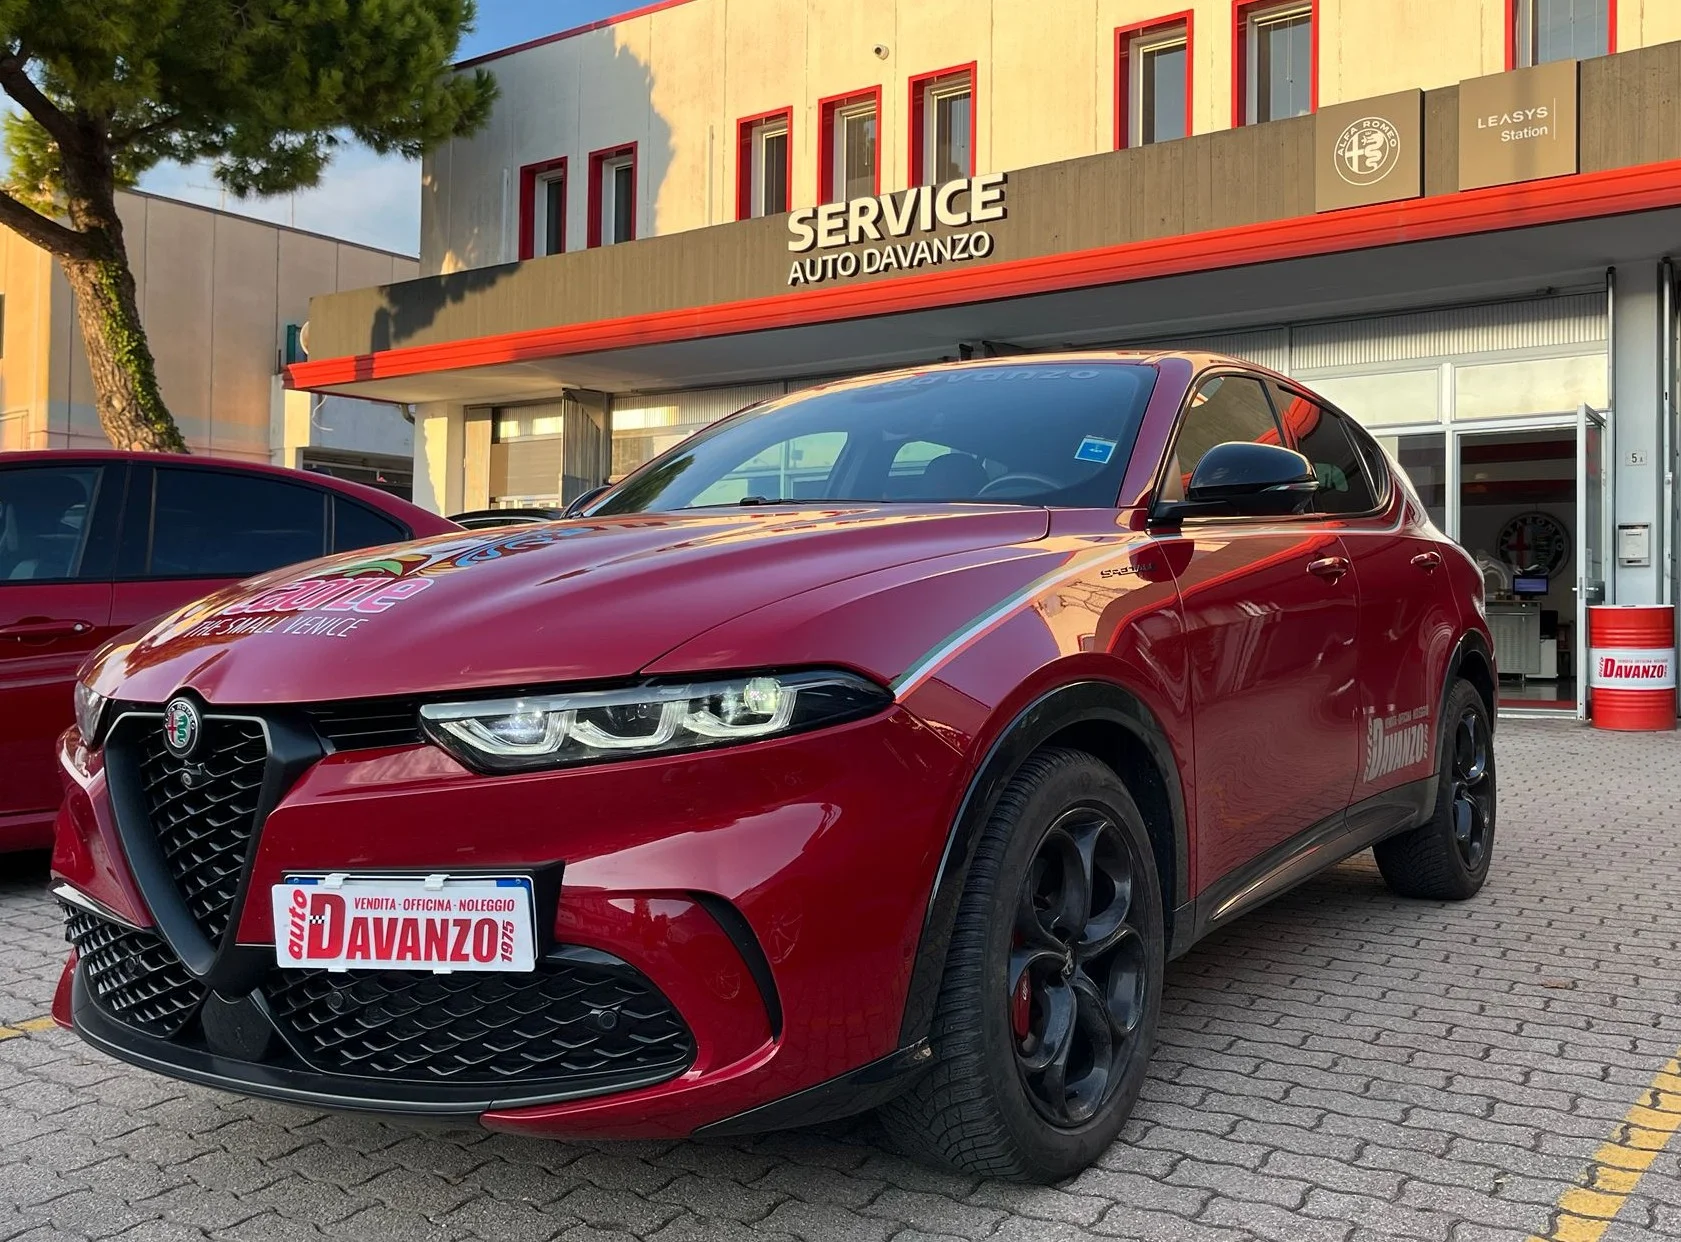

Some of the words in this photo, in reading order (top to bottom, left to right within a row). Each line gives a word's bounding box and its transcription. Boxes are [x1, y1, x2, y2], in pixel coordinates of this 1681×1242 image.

[1477, 106, 1548, 129] LEASYS
[1338, 127, 1358, 156] ALFA
[1363, 121, 1397, 147] ROMEO
[1500, 125, 1548, 142] Station
[788, 172, 1004, 252] SERVICE
[788, 252, 858, 285] AUTO
[863, 231, 991, 273] DAVANZO
[1631, 453, 1638, 463] 5
[183, 620, 222, 638] THE
[216, 616, 289, 635] SMALL
[282, 616, 369, 638] VENICE
[1603, 658, 1664, 678] DAVANZO
[354, 897, 396, 911] VENDITA
[403, 898, 451, 912] OFFICINA
[459, 899, 515, 912] NOLEGGIO
[288, 889, 307, 960] auto
[306, 893, 499, 963] DAVANZO
[501, 920, 515, 963] 1975
